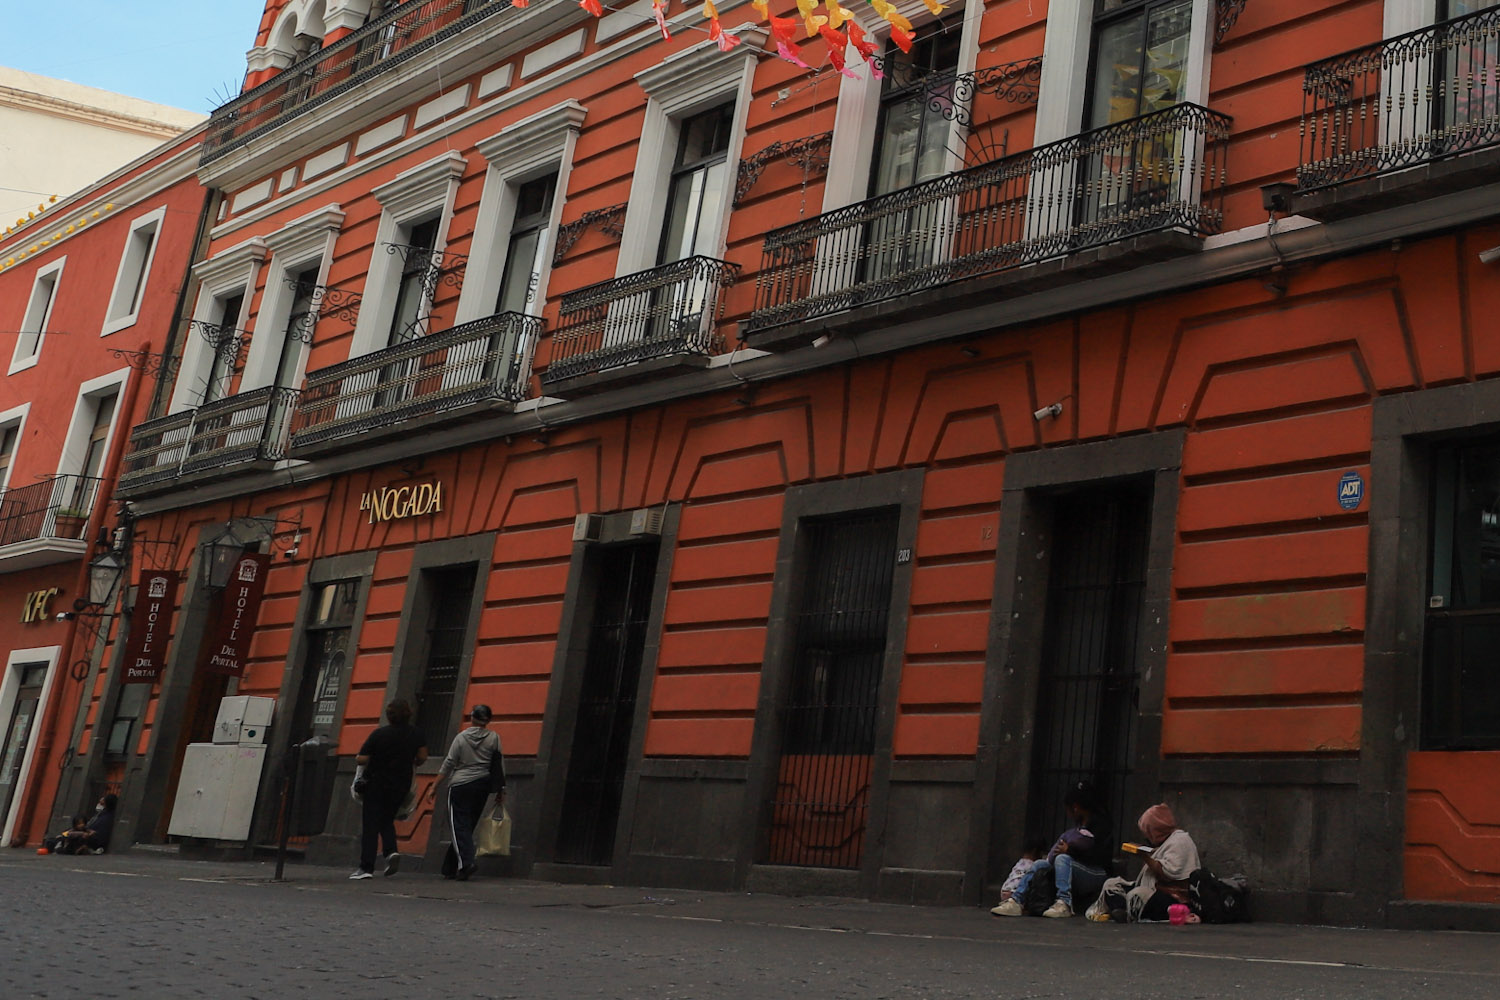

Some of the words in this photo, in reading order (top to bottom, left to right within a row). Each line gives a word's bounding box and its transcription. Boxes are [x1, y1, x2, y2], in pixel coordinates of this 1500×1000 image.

[359, 493, 370, 511] LA
[368, 481, 443, 525] NOGADA
[1341, 481, 1360, 497] ADT
[897, 549, 911, 563] 203
[19, 587, 59, 624] KFC
[229, 587, 249, 641] HOTEL
[143, 603, 160, 653] HOTEL
